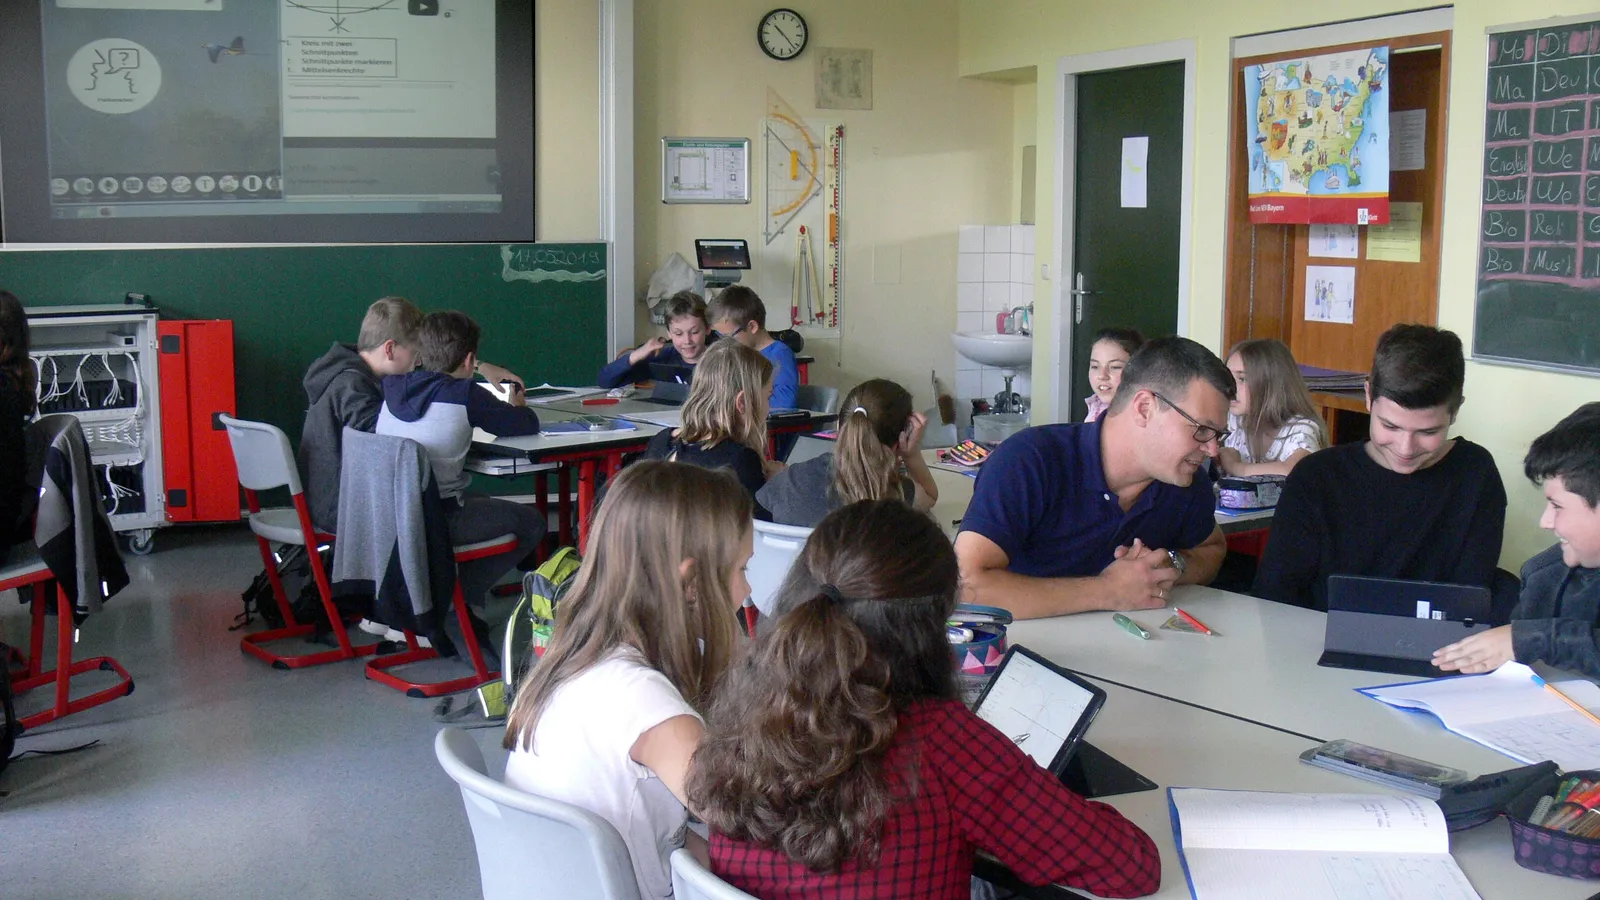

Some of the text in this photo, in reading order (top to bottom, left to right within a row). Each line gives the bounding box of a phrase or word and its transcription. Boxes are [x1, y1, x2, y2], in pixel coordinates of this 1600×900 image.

[1498, 32, 1567, 63] Mo Di
[1495, 75, 1525, 100] Ma
[1493, 111, 1521, 137] Ma
[1551, 108, 1580, 132] IT
[1538, 145, 1573, 168] We
[1485, 212, 1517, 236] Bio
[1485, 248, 1513, 272] Bio
